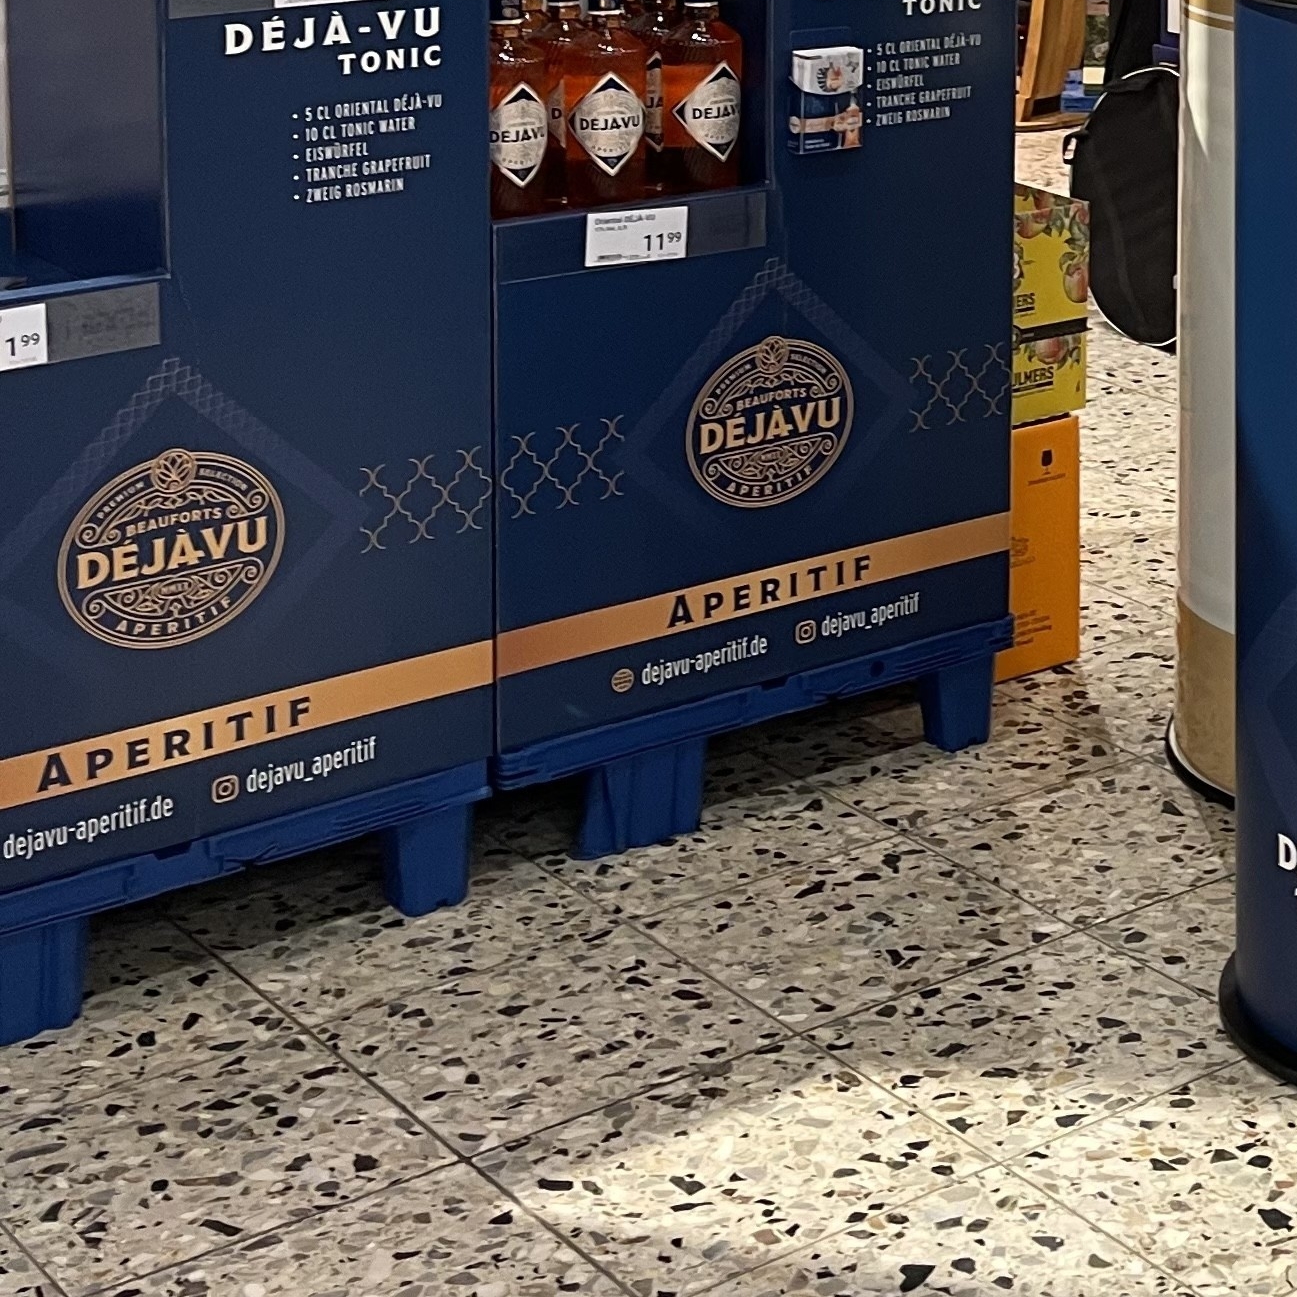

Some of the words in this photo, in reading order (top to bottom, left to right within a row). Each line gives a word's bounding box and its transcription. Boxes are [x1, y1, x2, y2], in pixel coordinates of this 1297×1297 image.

[224, 6, 441, 55] DÉJÀ-VU
[337, 45, 442, 75] TONIC
[876, 44, 883, 56] 5
[885, 42, 896, 55] CL
[899, 38, 941, 54] ORIENTAL
[889, 59, 901, 72] CL
[903, 56, 930, 71] TONIC
[932, 52, 960, 67] WATER
[305, 107, 313, 122] 5
[317, 106, 331, 121] CL
[334, 100, 390, 119] ORIENTAL
[876, 92, 916, 109] TRANCHE
[919, 85, 972, 104] GRAPEFRUIT
[305, 127, 319, 142] 10
[322, 125, 337, 140] CL
[340, 121, 376, 138] TONIC
[379, 116, 416, 133] WATER
[305, 142, 369, 163] EISWÜRFEL
[306, 163, 359, 183] TRANCHE
[362, 154, 432, 176] GRAPEFRUIT
[306, 185, 342, 203] ZWEIG
[345, 178, 404, 198] ROSMARIN
[735, 388, 808, 411] BEAUFORTS
[726, 465, 813, 497] APERITIF
[125, 507, 223, 538] BEAUFORTS
[665, 555, 873, 628] APERITIF
[115, 597, 233, 637] APERITIF
[641, 634, 769, 688] dejavu-aperitif.de
[820, 591, 921, 638] dejavu_aperitif
[36, 696, 312, 794] APERITIF
[3, 794, 175, 861] dejavu-aperitif.de
[246, 736, 378, 794] dejavu_aperitif
